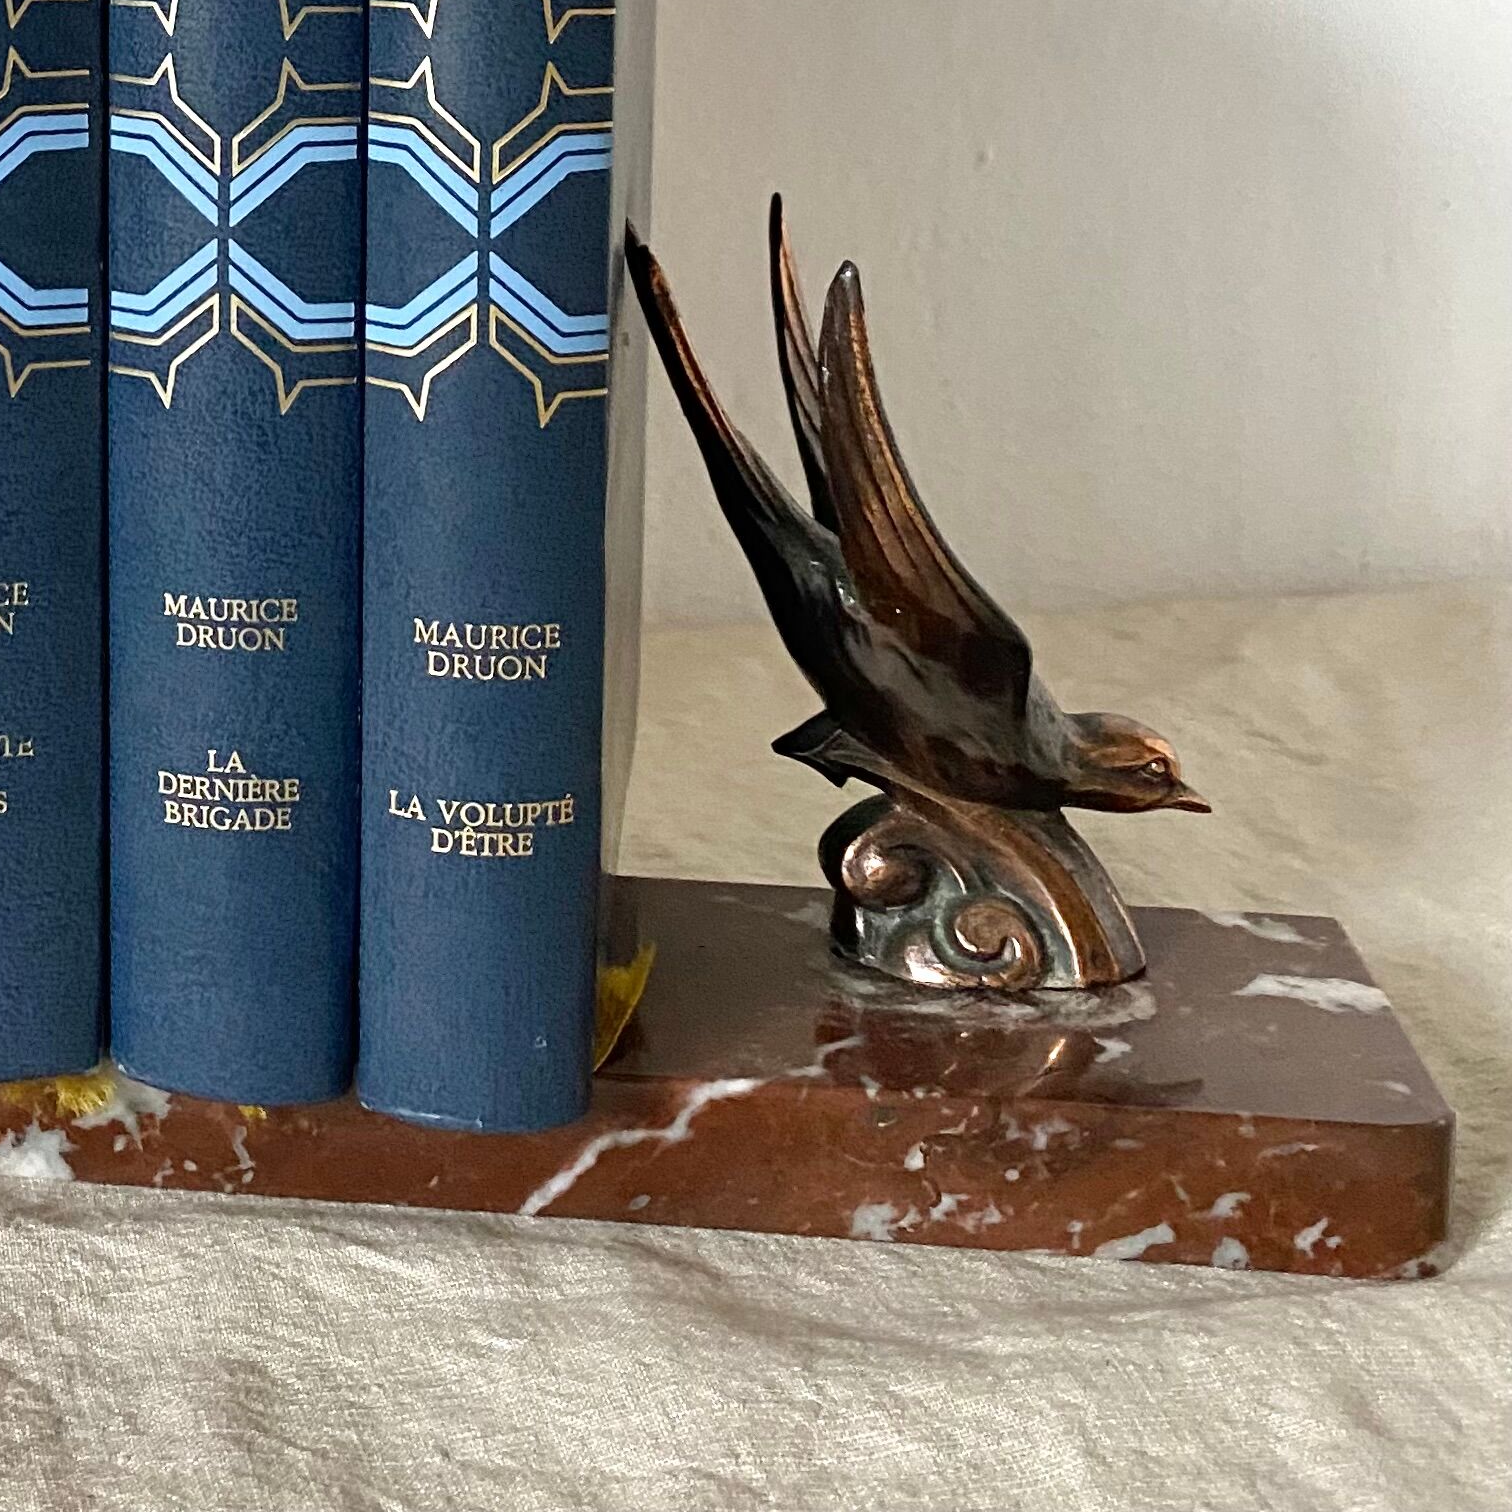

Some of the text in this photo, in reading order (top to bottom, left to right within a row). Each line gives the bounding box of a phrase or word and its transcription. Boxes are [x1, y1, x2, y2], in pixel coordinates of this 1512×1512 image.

[163, 592, 299, 623] MAURICE
[176, 623, 286, 651] DRUON
[413, 617, 562, 651] MAURICE
[427, 650, 548, 680] DRUON
[207, 749, 247, 774] LA
[157, 770, 300, 803] DERNIÈRE
[163, 799, 292, 832] BRIGADE
[388, 789, 575, 827] LA VOLUPTÉ
[430, 824, 535, 857] D'ÊTRE
